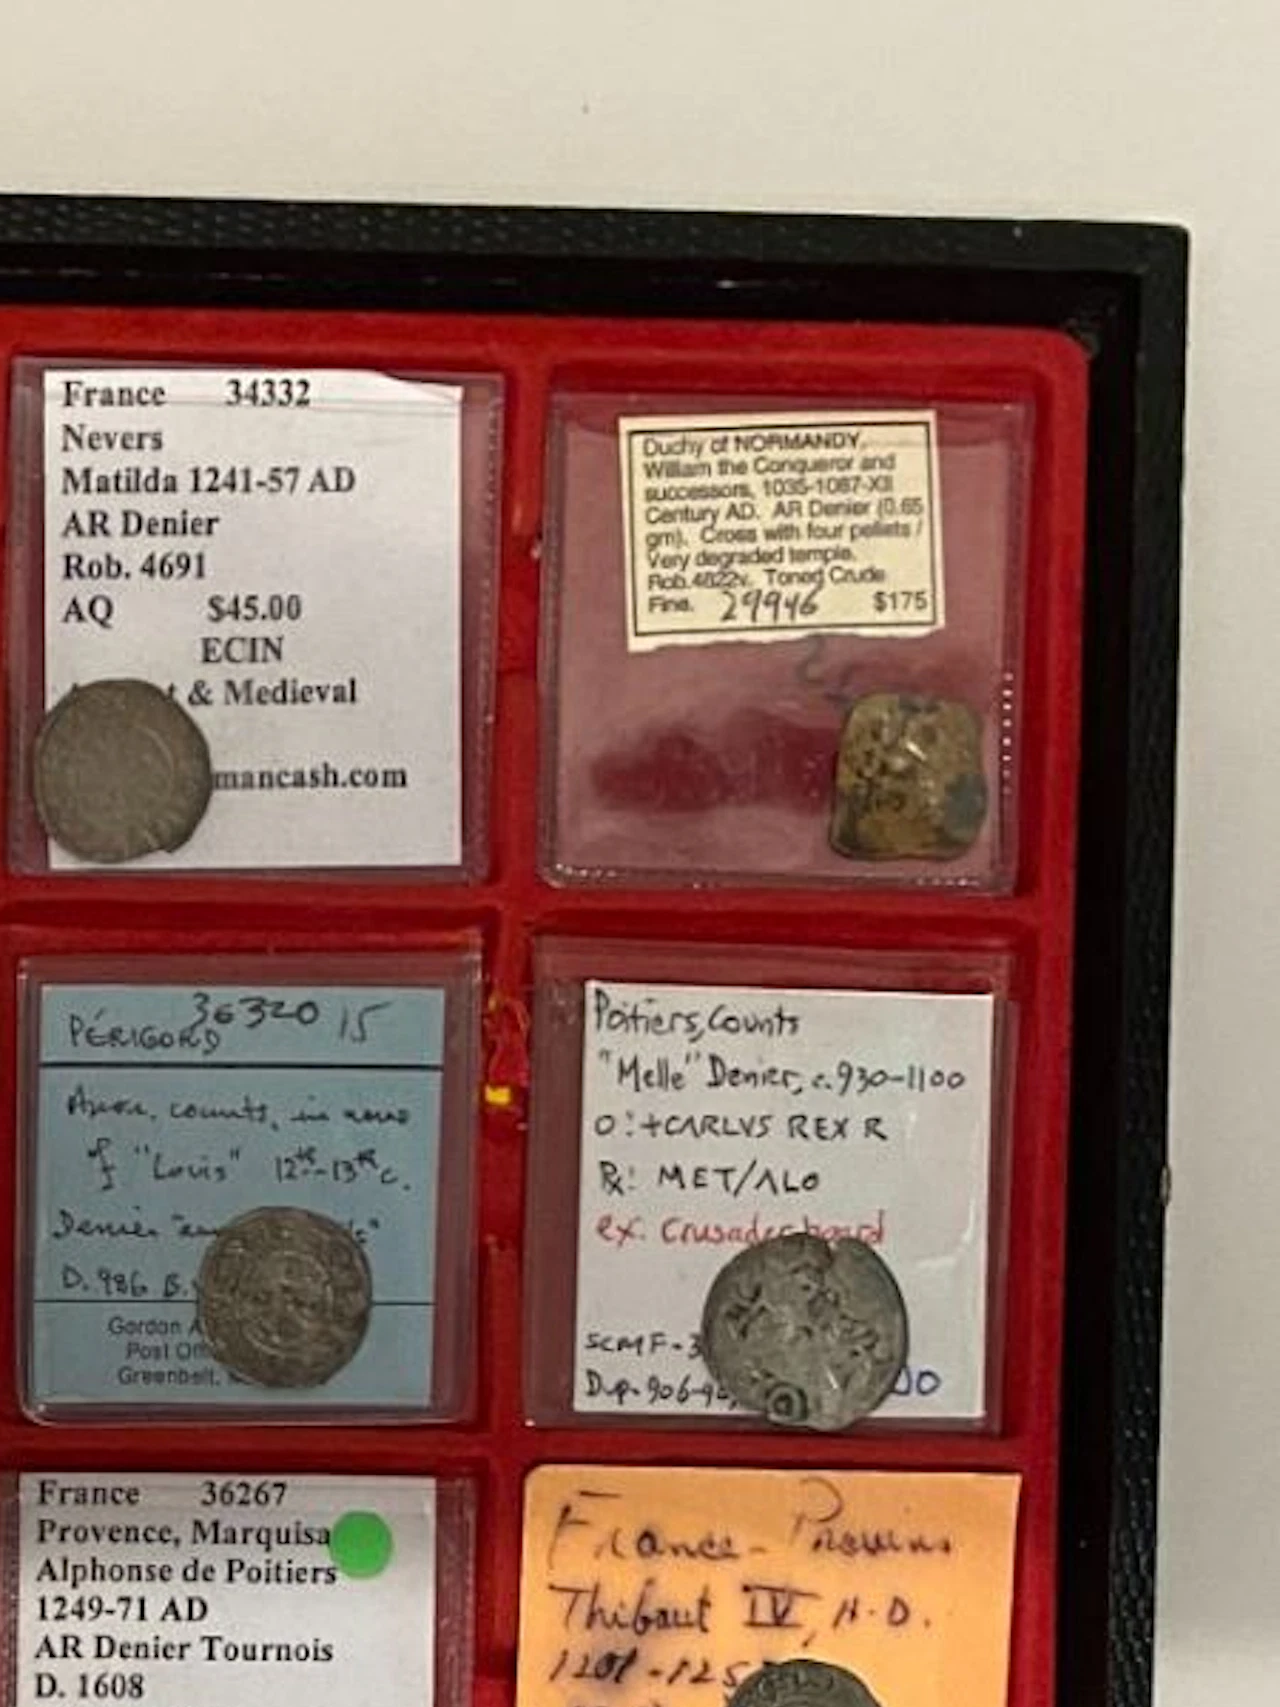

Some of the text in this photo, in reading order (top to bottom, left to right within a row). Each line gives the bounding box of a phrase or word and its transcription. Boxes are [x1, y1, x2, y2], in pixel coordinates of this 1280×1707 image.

[62, 424, 163, 451] Nevers
[643, 436, 703, 458] Duchy
[711, 437, 729, 453] of
[62, 467, 356, 494] Matilda 1241-57 AD
[62, 554, 207, 580] Rob. 4691
[873, 592, 927, 612] $175
[788, 1115, 888, 1141] REX R
[38, 1480, 288, 1506] France 36267
[36, 1558, 337, 1588] Alphonse de Poitiers
[35, 1637, 334, 1662] AR Denier Tournois
[35, 1673, 145, 1698] D. 1608
